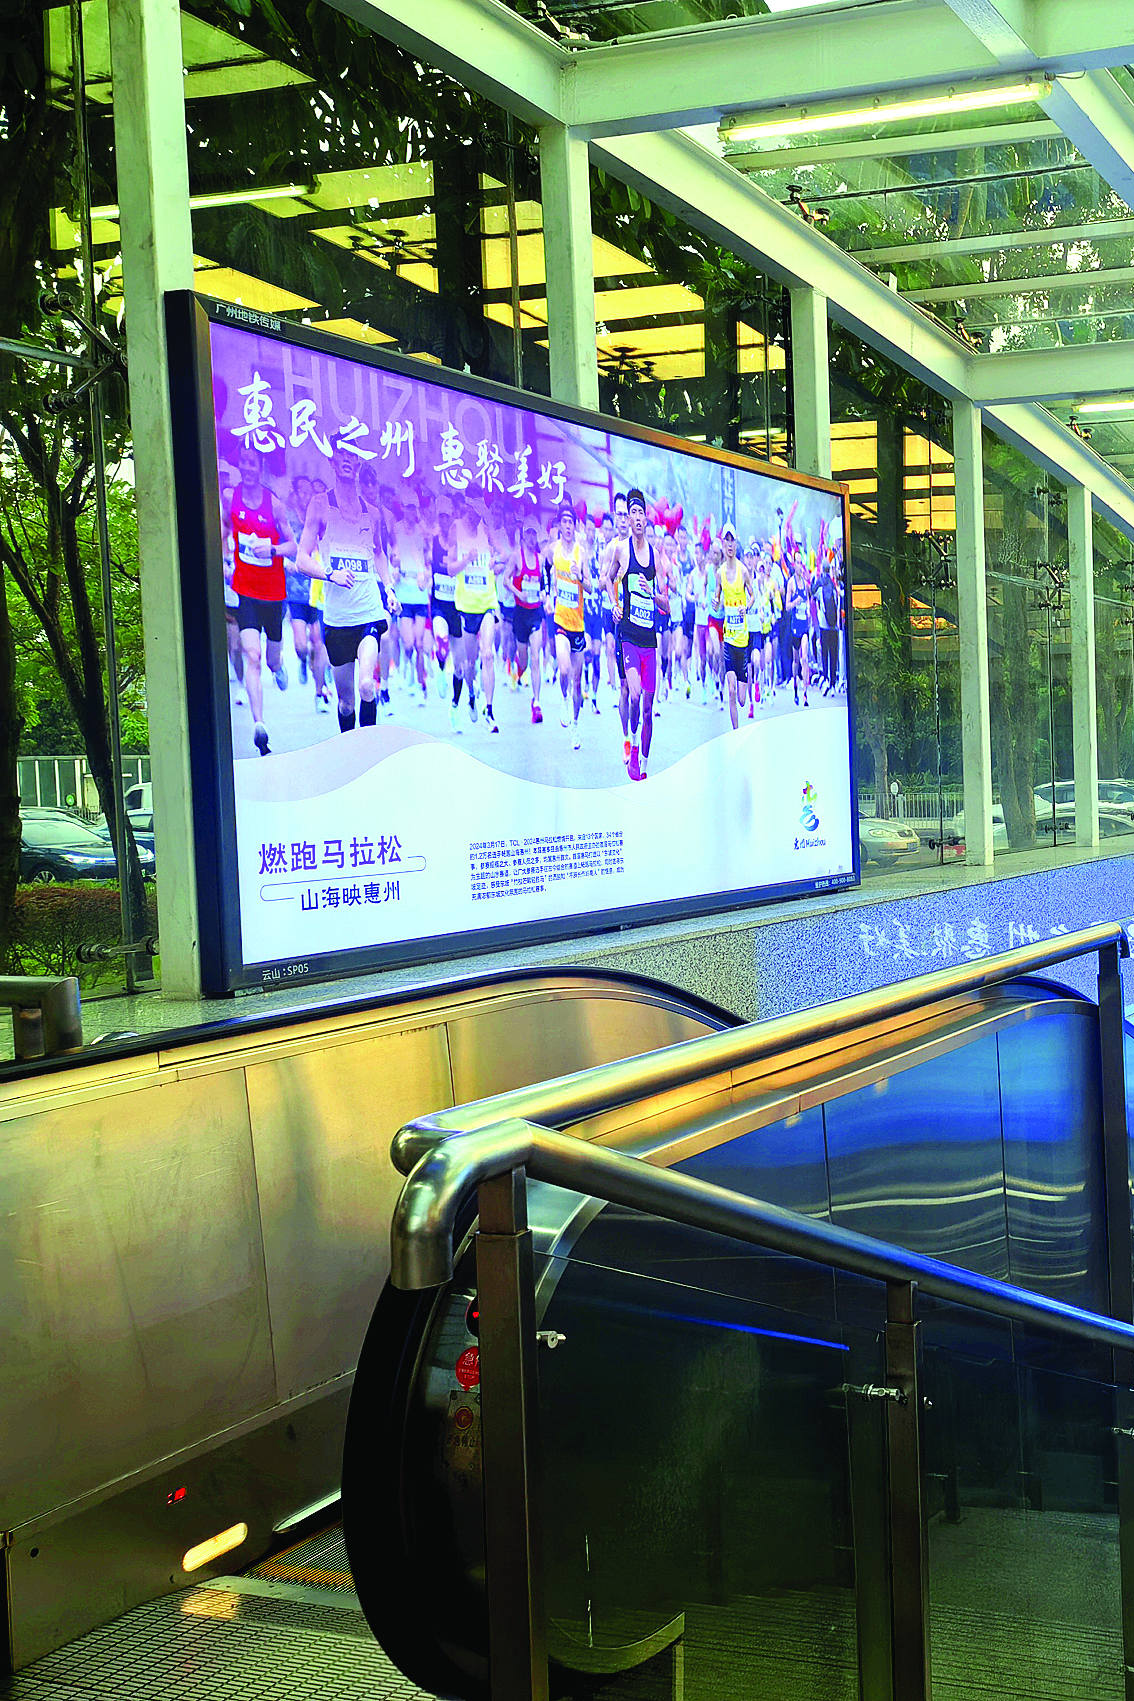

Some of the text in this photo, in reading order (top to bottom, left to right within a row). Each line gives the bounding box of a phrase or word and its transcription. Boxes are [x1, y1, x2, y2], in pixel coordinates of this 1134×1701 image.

[216, 303, 281, 331] 广州地铁传媒
[282, 346, 524, 463] HUIZHOU
[230, 371, 568, 505] 惠民之州 惠聚美好
[337, 558, 363, 572] A098
[634, 608, 651, 620] A002
[258, 835, 402, 875] 燃跑马拉松
[301, 880, 400, 911] 山海映惠州
